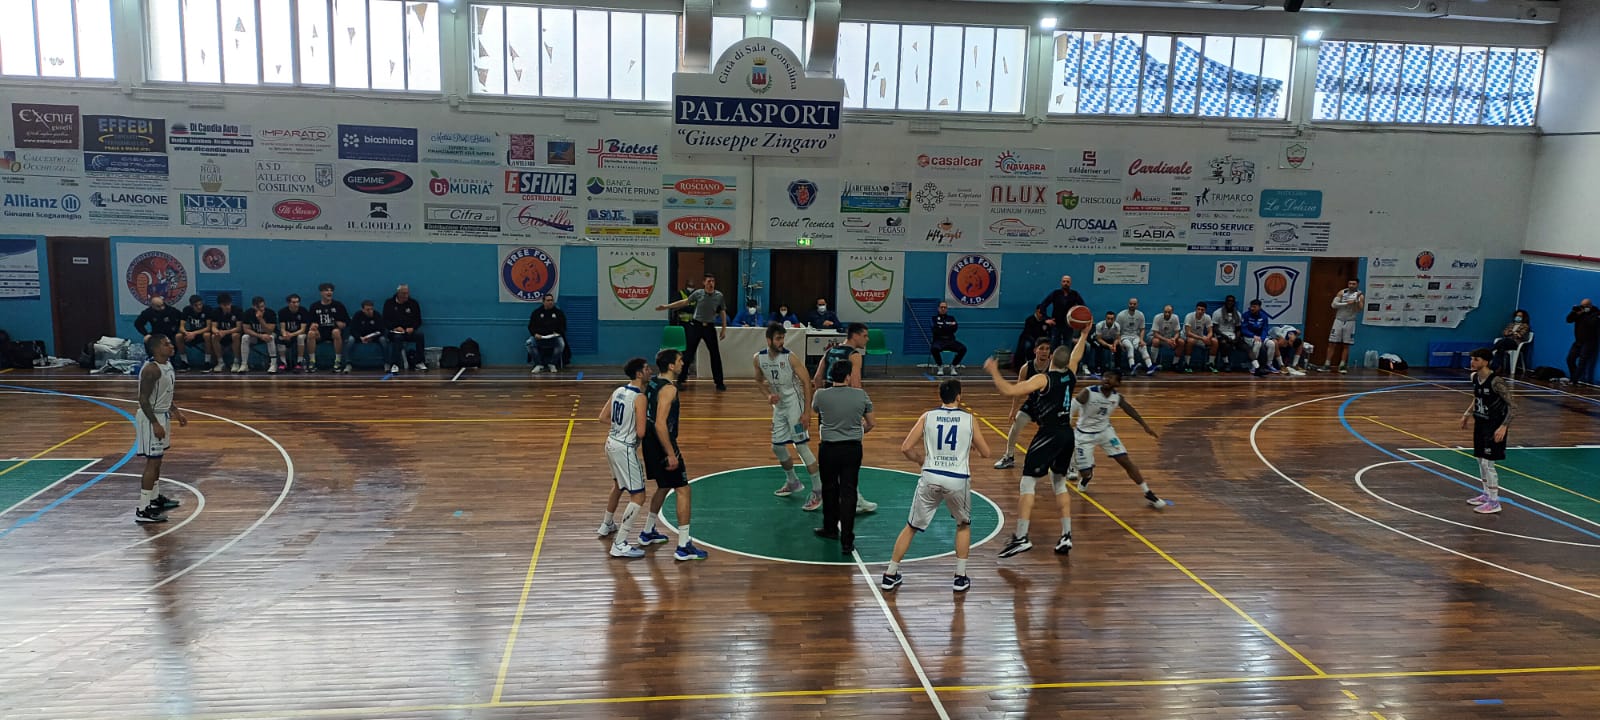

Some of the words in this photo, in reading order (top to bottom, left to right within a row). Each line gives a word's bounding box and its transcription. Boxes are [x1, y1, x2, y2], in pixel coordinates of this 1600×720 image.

[719, 60, 735, 84] Città
[735, 47, 745, 62] di
[745, 43, 766, 55] Sala
[770, 47, 797, 90] Consilina
[680, 100, 836, 126] PALASPORT
[97, 118, 153, 134] EFFEBI
[223, 124, 238, 133] Auto
[262, 129, 327, 138] IMPARATO
[364, 136, 414, 146] biochimica
[605, 139, 658, 154] Biotest
[931, 156, 984, 167] casalcar
[1128, 159, 1193, 176] Cardinale
[257, 174, 306, 182] ATLETICO
[348, 176, 385, 184] GIEMME
[258, 183, 315, 193] COSILINVM
[434, 183, 447, 193] Di
[450, 185, 490, 195] MURIA
[606, 187, 632, 195] MONTE
[680, 183, 721, 191] ROSCIANO
[4, 194, 58, 208] Allianz
[112, 194, 168, 204] LANGONE
[186, 195, 246, 210] NEXT
[1212, 193, 1254, 202] TRIMARCO
[450, 209, 483, 220] Cifra
[361, 222, 411, 230] GIOIELLO
[674, 222, 725, 231] ROSCIANO
[770, 217, 800, 227] Diesel
[802, 218, 835, 228] Tecnica
[1056, 218, 1117, 231] AUTOSALA
[1133, 229, 1175, 239] SABIA
[507, 249, 530, 267] FREE
[533, 250, 552, 267] FOX
[953, 256, 974, 273] FREE
[977, 258, 995, 273] FOX
[617, 287, 649, 295] ANTARES
[771, 370, 779, 380] 12
[1063, 385, 1071, 411] 4
[936, 424, 958, 451] 14
